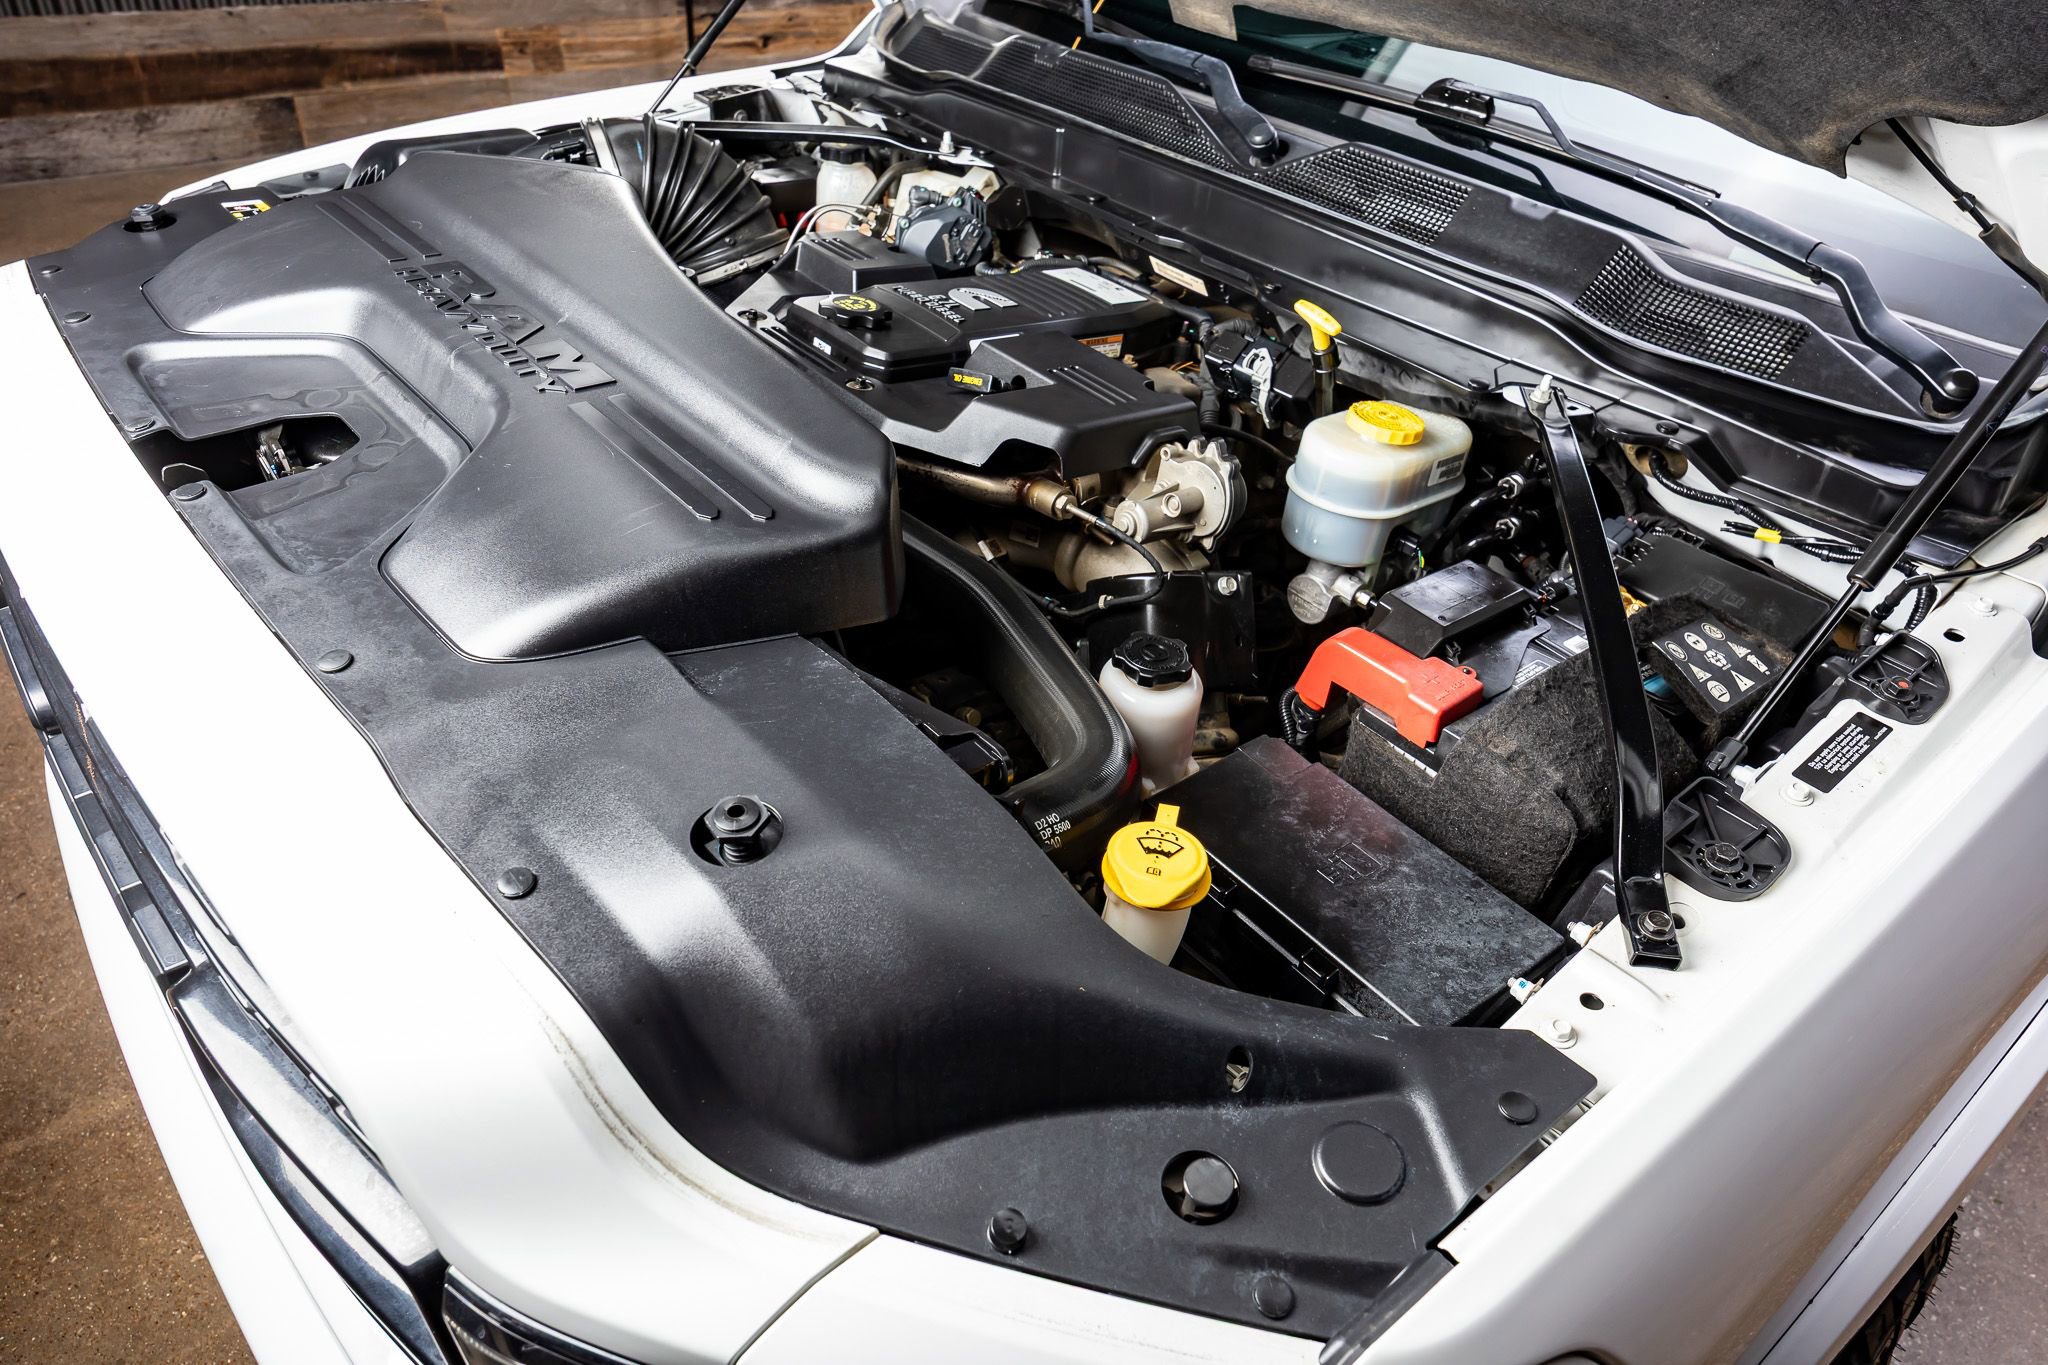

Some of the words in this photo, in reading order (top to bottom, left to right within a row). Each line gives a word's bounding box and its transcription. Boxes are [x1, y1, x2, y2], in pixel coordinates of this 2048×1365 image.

[925, 301, 965, 323] DIESEL
[393, 266, 489, 330] HEAVY
[474, 331, 569, 393] DUTY
[420, 260, 617, 392] RAM
[1034, 818, 1048, 830] D2
[1045, 812, 1060, 825] HO
[1040, 827, 1053, 840] DP
[1053, 820, 1071, 834] 5500
